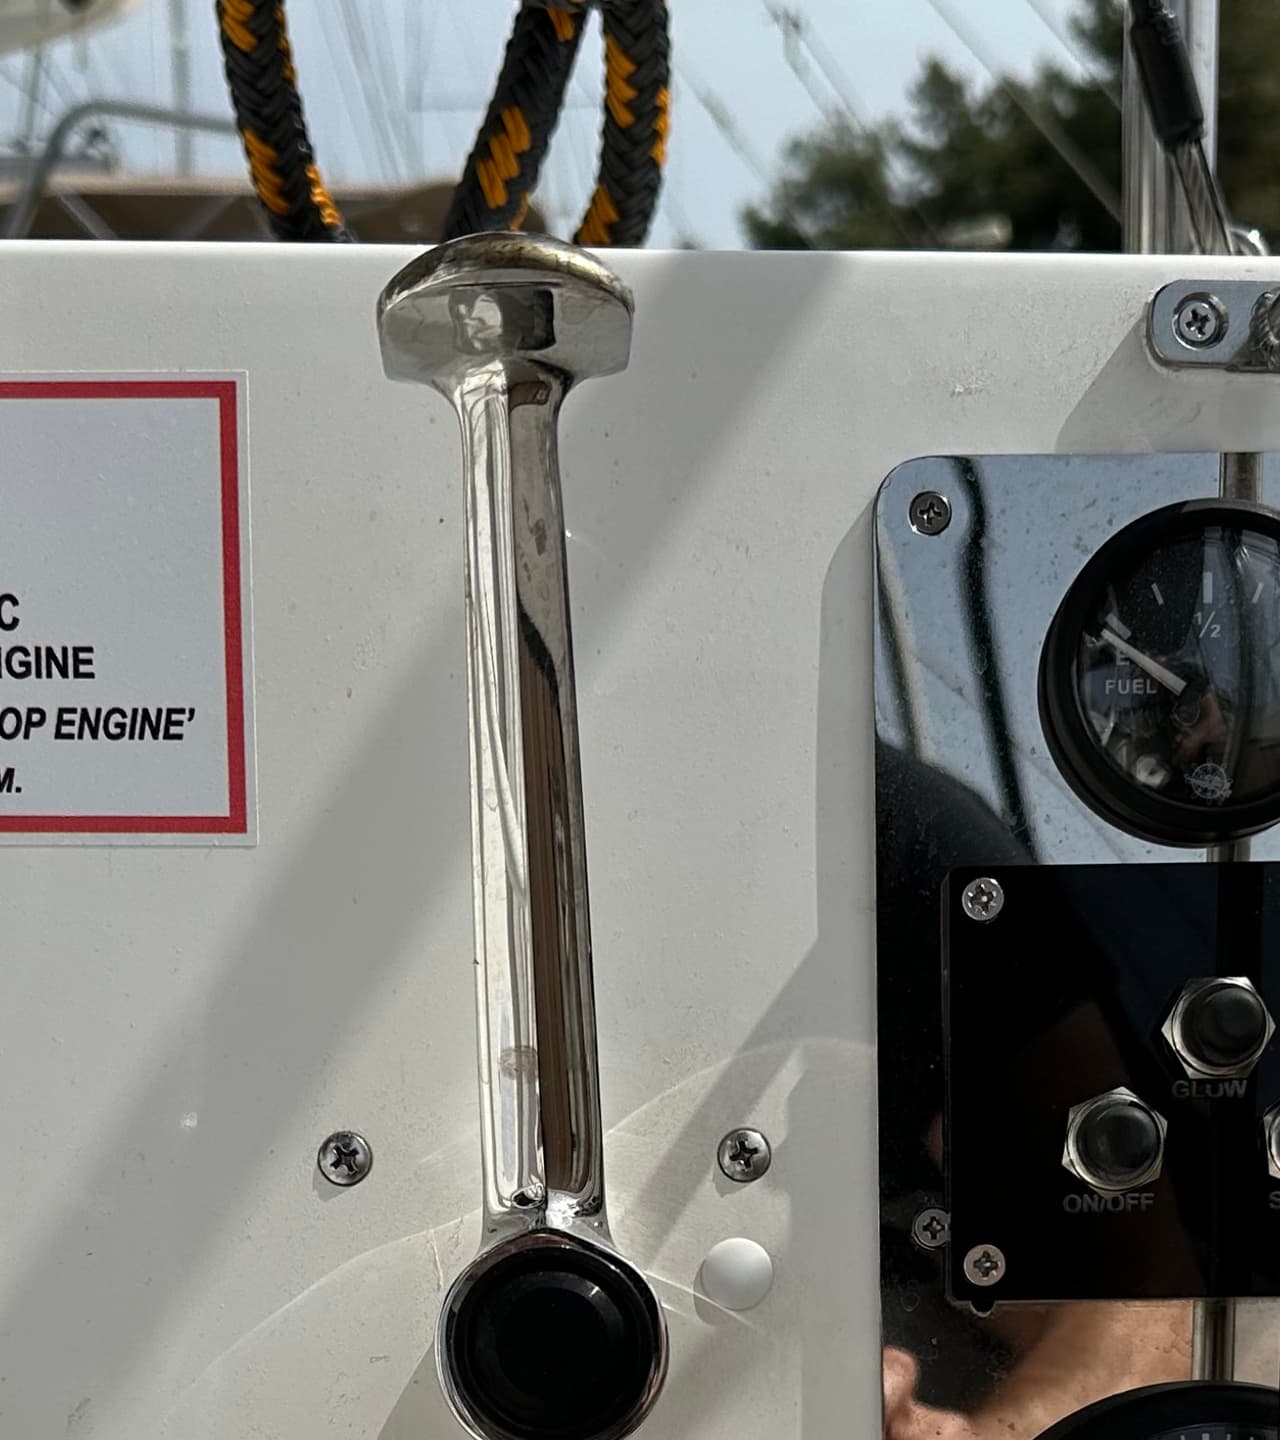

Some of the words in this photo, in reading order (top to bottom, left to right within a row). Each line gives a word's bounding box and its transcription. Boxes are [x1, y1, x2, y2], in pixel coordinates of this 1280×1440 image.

[1104, 678, 1158, 696] FUEL
[1170, 1079, 1248, 1099] GLOW
[1062, 1193, 1156, 1214] ON/OFF
